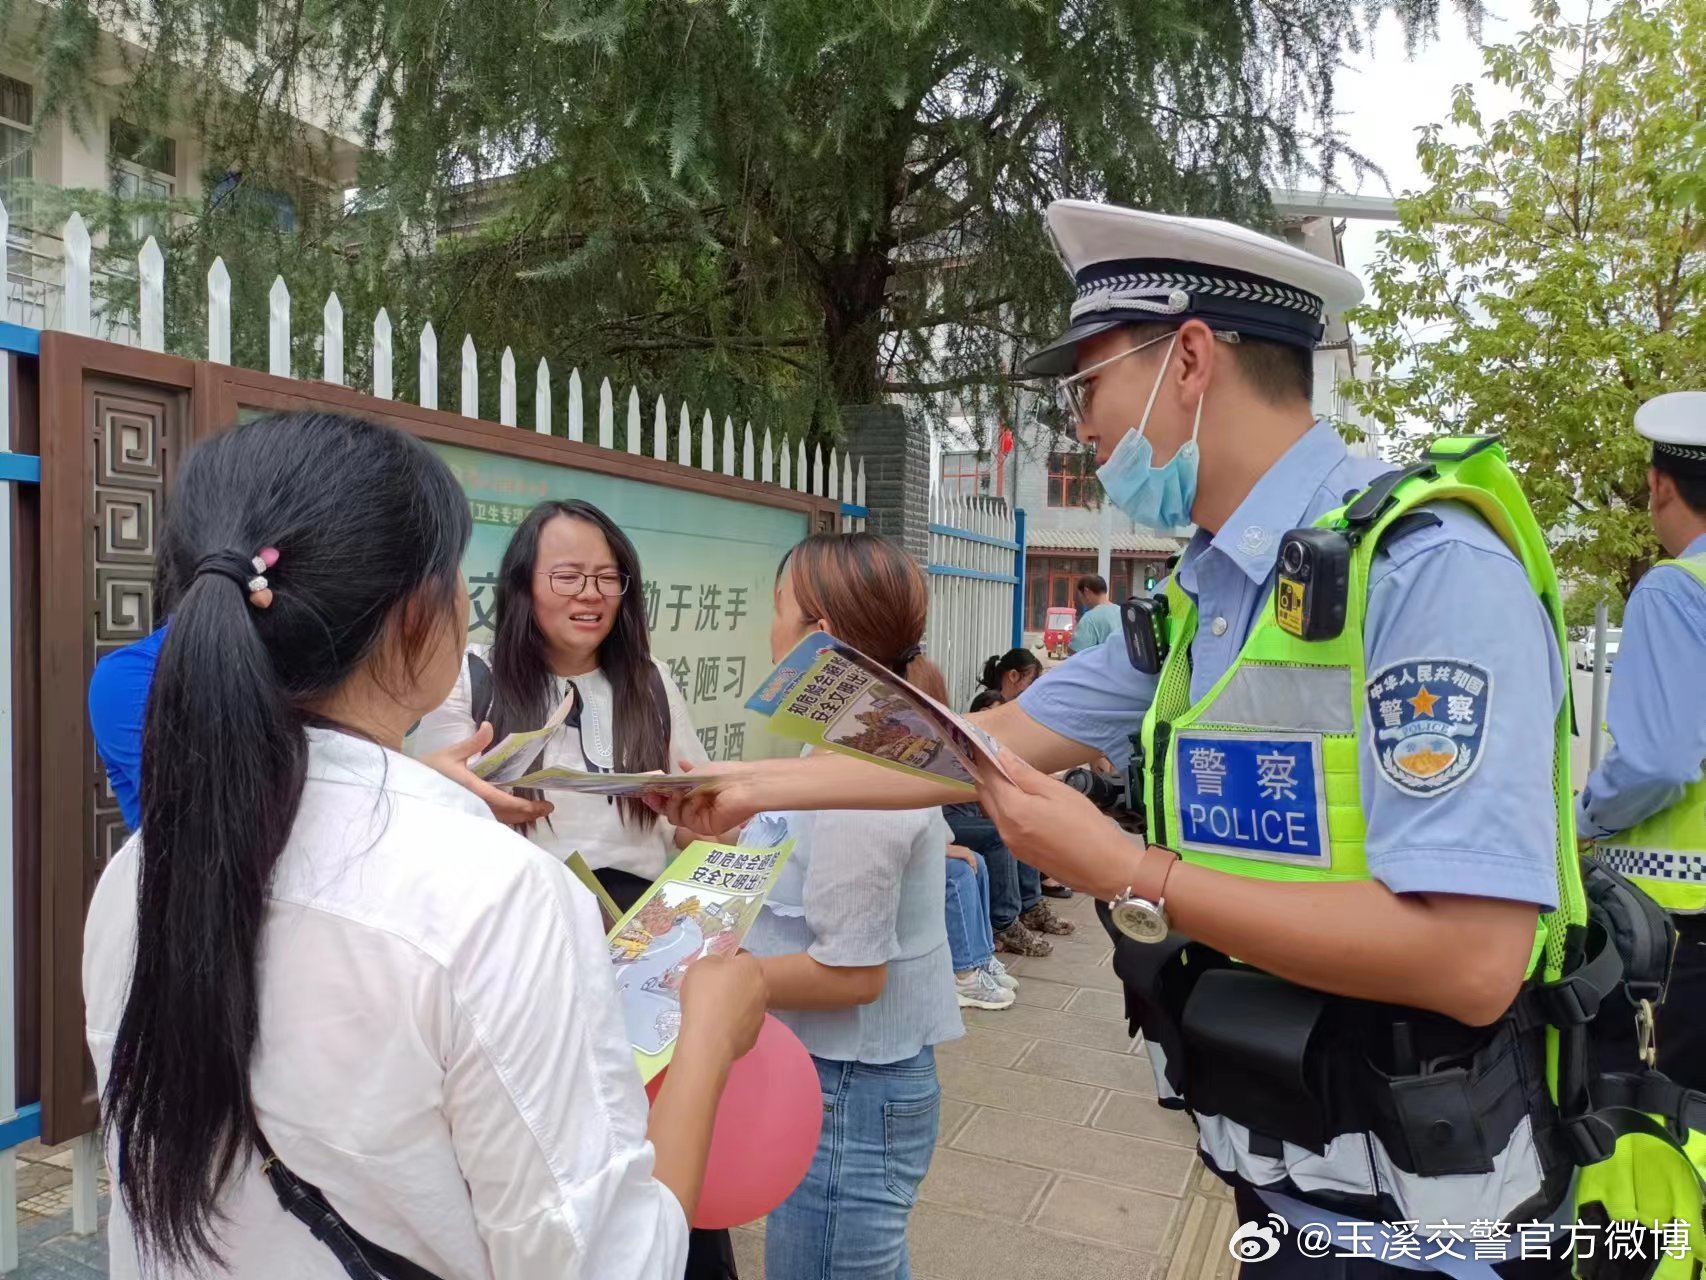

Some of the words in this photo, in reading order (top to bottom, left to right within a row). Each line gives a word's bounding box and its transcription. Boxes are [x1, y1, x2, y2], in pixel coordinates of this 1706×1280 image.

[470, 501, 530, 525] 卫生专项
[1370, 664, 1485, 699] 中华人民共和国
[1189, 747, 1299, 801] 警察
[1189, 803, 1308, 846] POLICE
